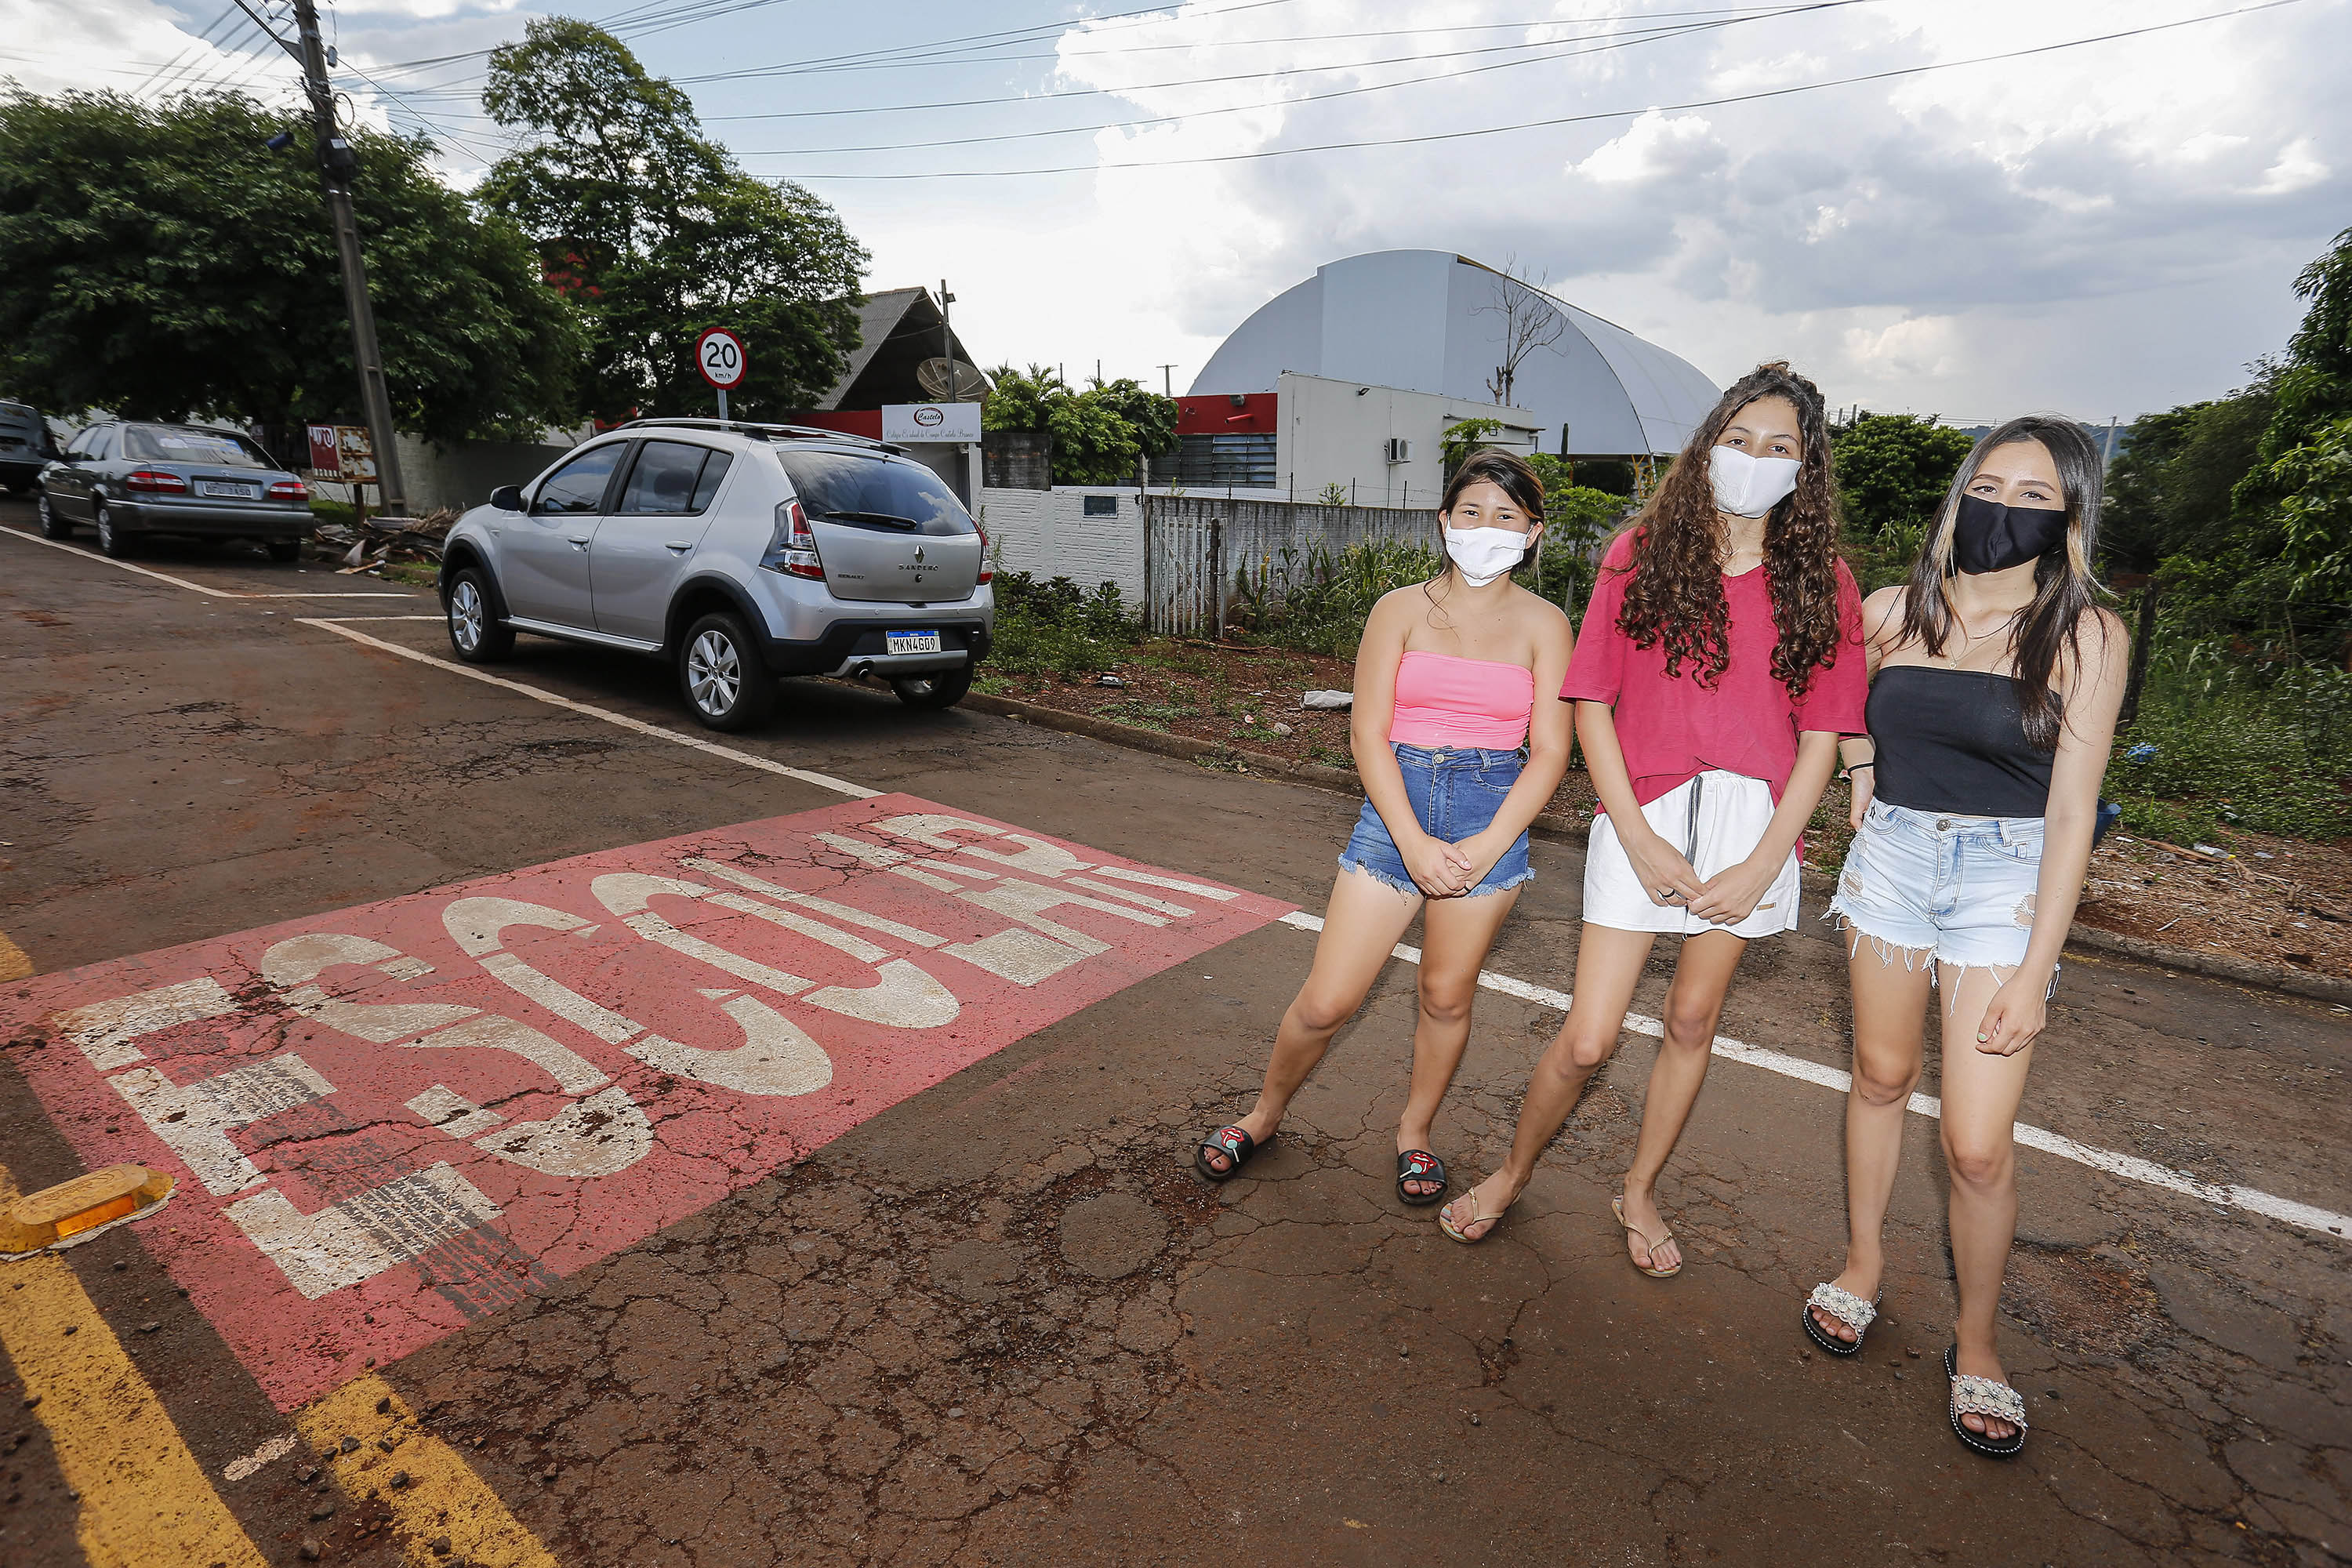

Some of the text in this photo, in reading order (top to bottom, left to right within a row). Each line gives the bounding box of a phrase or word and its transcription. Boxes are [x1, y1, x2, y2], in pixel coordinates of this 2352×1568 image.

[706, 342, 737, 368] 20
[918, 412, 941, 421] Castelo
[893, 637, 935, 652] MKN4G09
[52, 813, 1240, 1300] ESCOLAR
